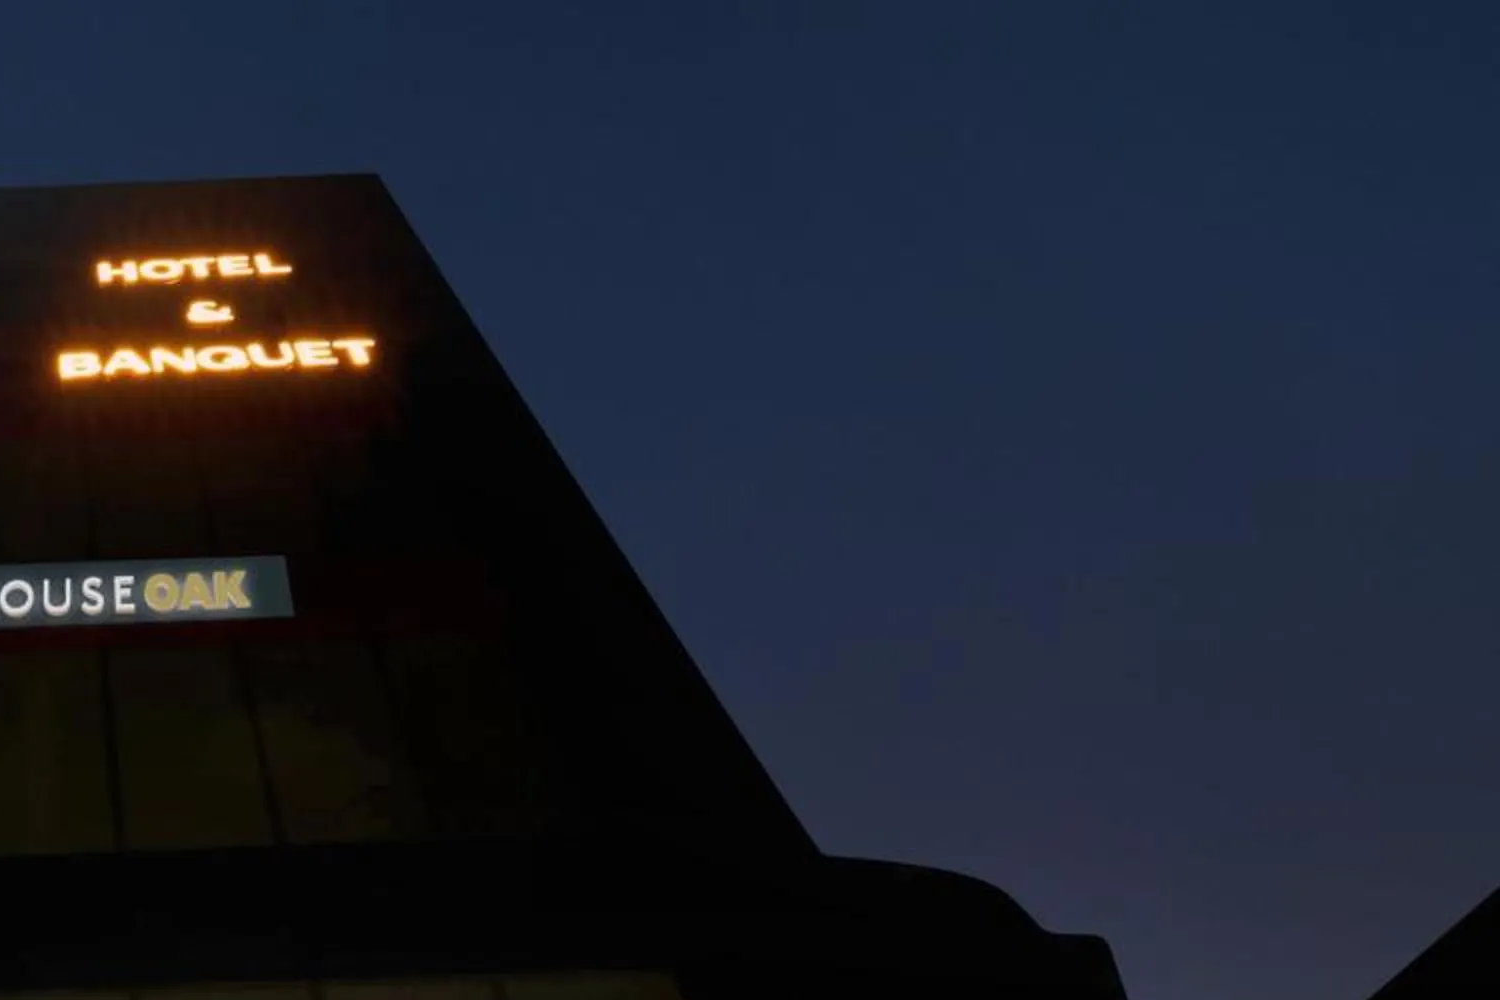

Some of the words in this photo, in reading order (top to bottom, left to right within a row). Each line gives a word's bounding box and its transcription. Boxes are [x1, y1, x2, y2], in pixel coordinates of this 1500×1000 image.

[95, 252, 292, 285] HOTEL
[185, 299, 234, 325] &
[56, 337, 375, 381] BANQUET
[143, 569, 251, 613] OAK
